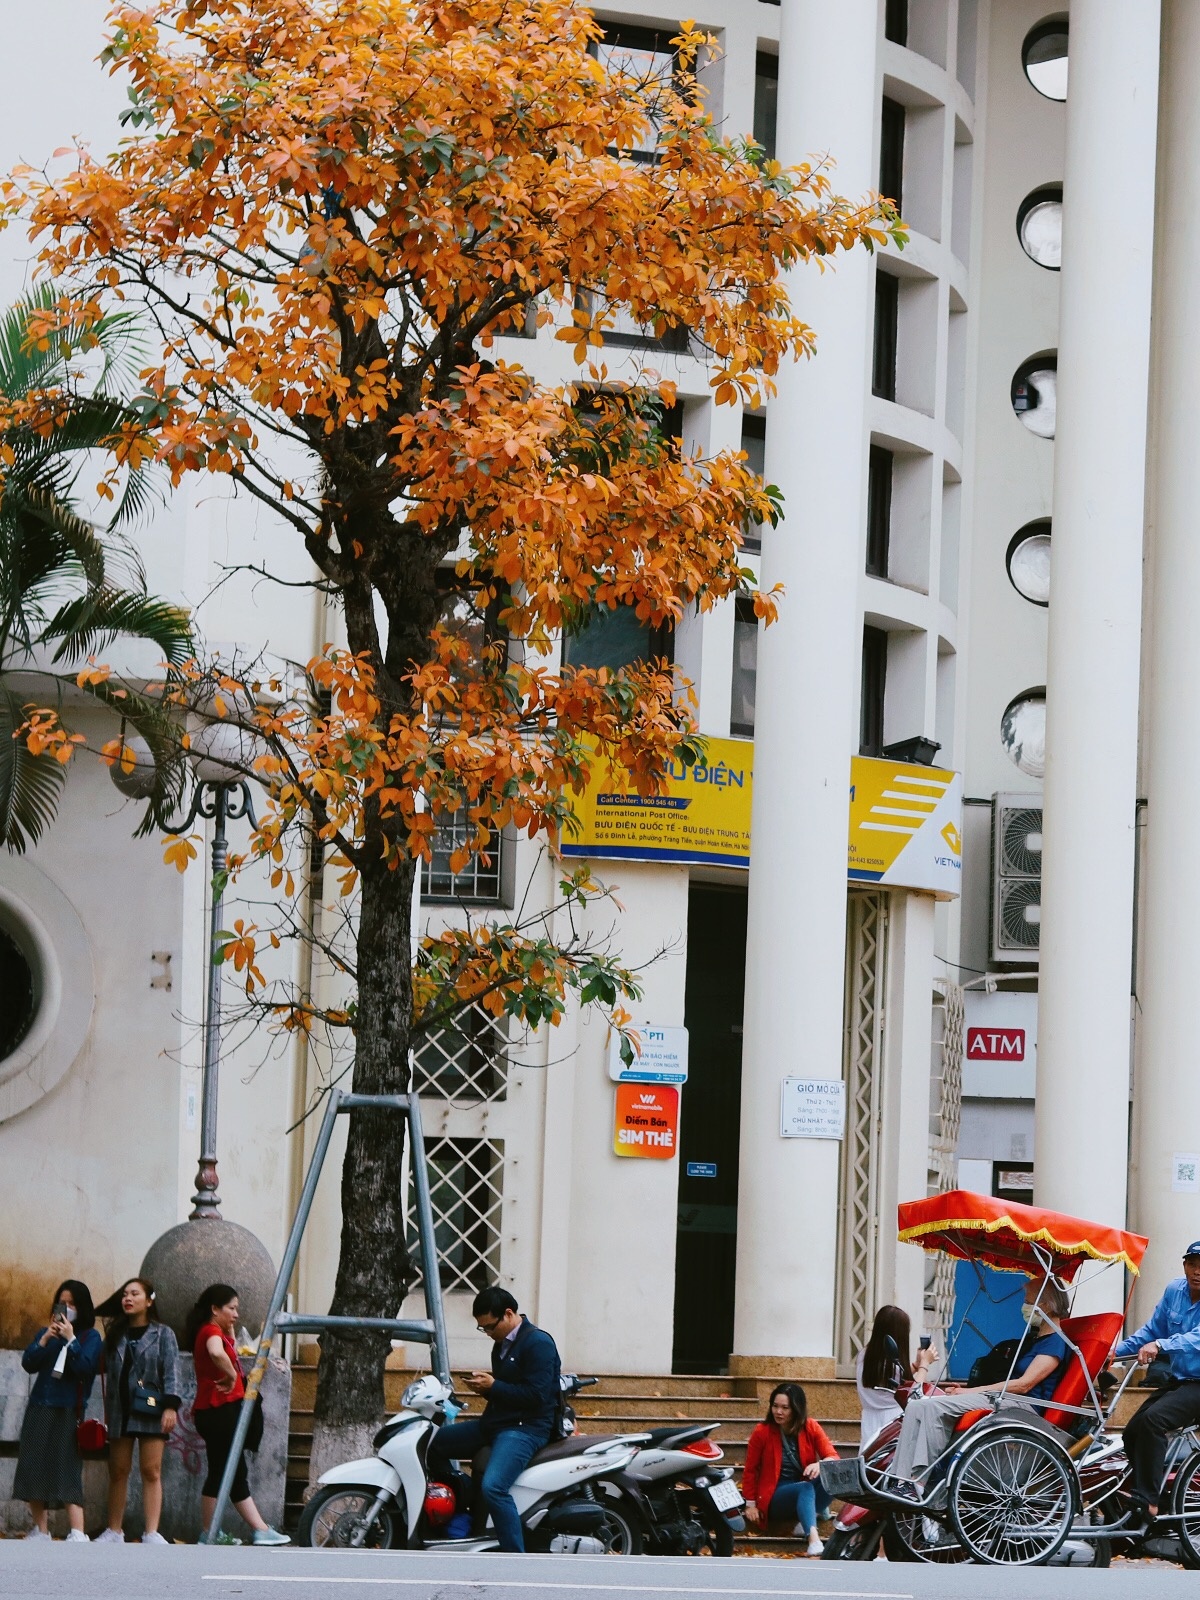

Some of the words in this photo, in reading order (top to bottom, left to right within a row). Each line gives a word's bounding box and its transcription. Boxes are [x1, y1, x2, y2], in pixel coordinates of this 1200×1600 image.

[692, 761, 744, 791] ĐIỆN
[596, 809, 647, 818] International
[595, 820, 613, 829] BƯU
[615, 821, 636, 831] ĐIỆN
[639, 820, 664, 831] QUỐC
[666, 822, 676, 832] TẾ
[683, 826, 698, 834] BƯU
[699, 827, 714, 836] ĐIỆN
[717, 830, 738, 838] TRUNG
[742, 831, 752, 840] TÂ
[848, 843, 857, 854] ỘI
[649, 1032, 664, 1041] PTI
[970, 1033, 1023, 1055] ATM
[797, 1083, 815, 1093] GIỜ
[651, 1116, 668, 1127] Bán
[619, 1129, 645, 1145] SIM
[645, 1128, 674, 1147] THẺ
